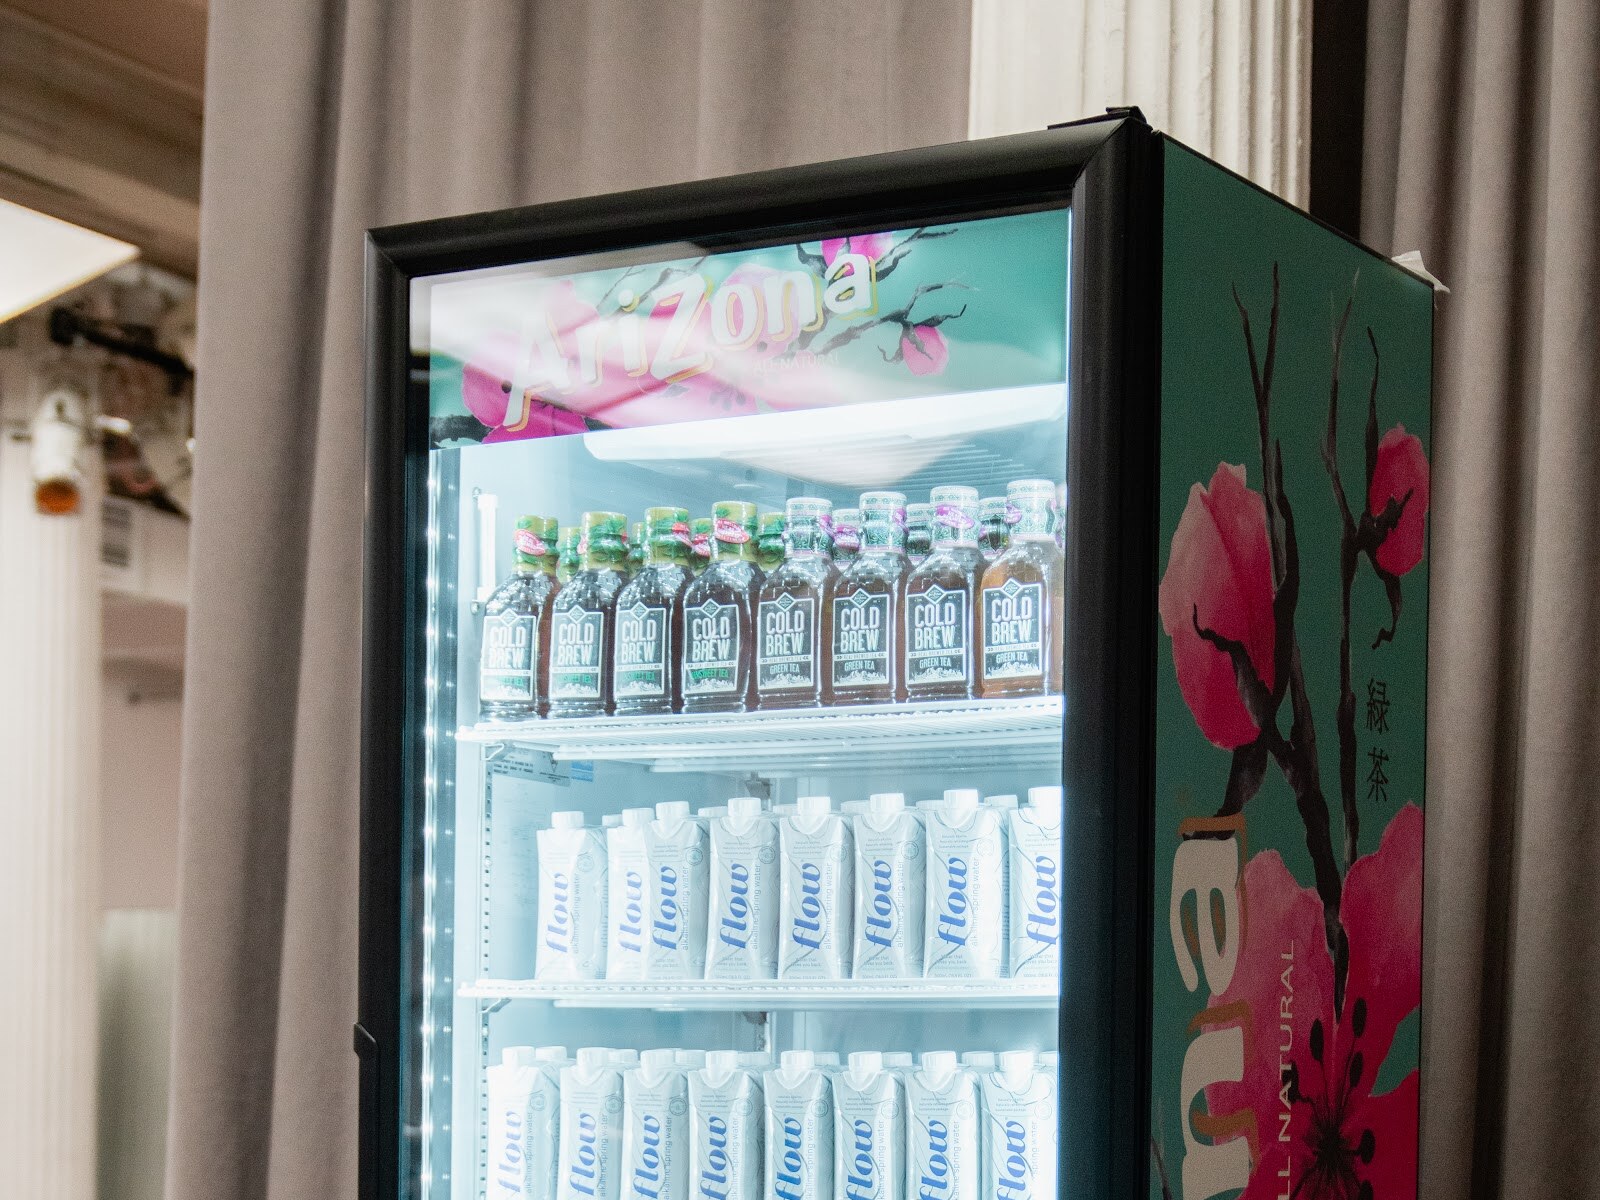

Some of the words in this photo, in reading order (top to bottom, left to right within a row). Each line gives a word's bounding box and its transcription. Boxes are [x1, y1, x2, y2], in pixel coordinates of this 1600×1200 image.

[502, 253, 878, 431] AriZona
[766, 610, 804, 634] COLD
[840, 606, 879, 630] COLD
[914, 602, 955, 627] COLD
[991, 597, 1032, 622] COLD
[490, 626, 527, 648] COLD
[559, 623, 594, 645] COLD
[621, 619, 657, 642] COLD
[692, 616, 730, 641] COLD
[840, 628, 879, 653] BREW
[914, 624, 956, 650] BREW
[991, 619, 1032, 645] BREW
[557, 644, 593, 666] BREW
[621, 640, 656, 663] BREW
[691, 639, 730, 661] BREW
[766, 632, 804, 656] BREW
[770, 663, 788, 675] GREEN
[789, 662, 800, 673] TEA
[844, 660, 863, 671] GREEN
[864, 660, 875, 670] TEA
[919, 658, 939, 669] GREEN
[940, 657, 951, 667] TEA
[995, 653, 1015, 664] GREEN
[1016, 652, 1028, 662] TEA
[618, 871, 642, 953] flow
[652, 866, 677, 950] flow
[719, 863, 749, 949] flow
[792, 862, 820, 950] flow
[865, 859, 892, 947] flow
[937, 857, 967, 946] flow
[1026, 855, 1057, 945] flow
[546, 873, 568, 953] flow
[1277, 938, 1295, 1144] NATURAL
[498, 1111, 521, 1193] flow
[571, 1114, 595, 1195] flow
[634, 1116, 659, 1198] flow
[701, 1116, 727, 1200] flow
